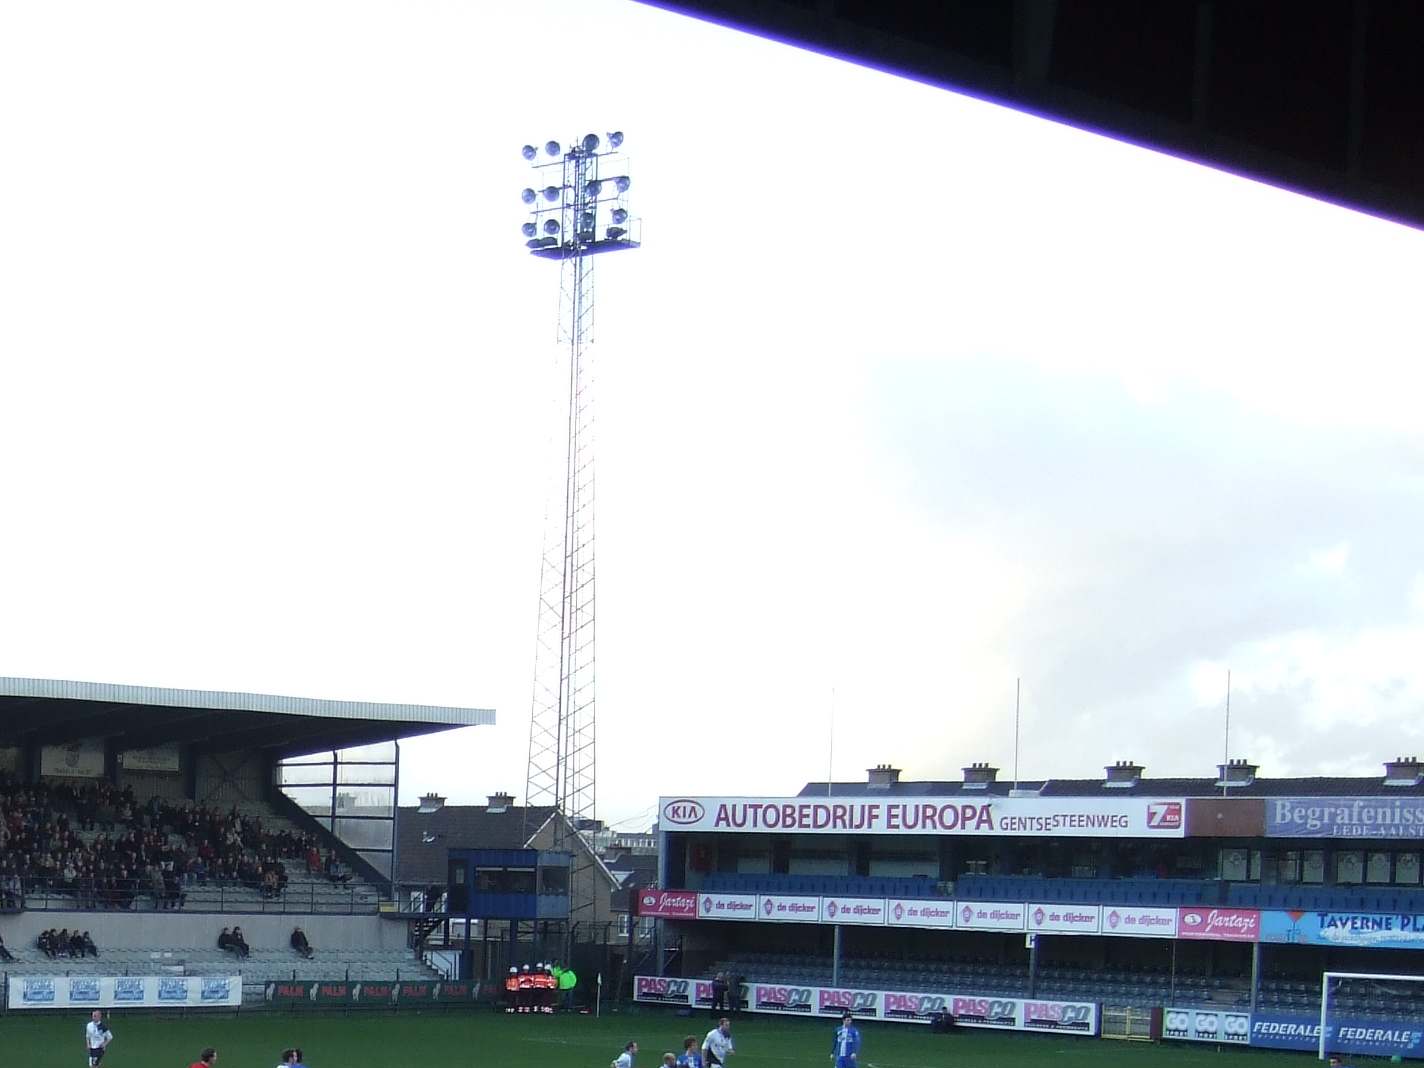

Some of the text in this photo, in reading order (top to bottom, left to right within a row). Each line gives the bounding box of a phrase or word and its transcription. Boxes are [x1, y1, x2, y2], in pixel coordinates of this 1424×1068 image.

[671, 806, 698, 819] KIA
[713, 803, 881, 830] AUTOBEDRIJF
[886, 804, 994, 831] EUROPA
[1049, 912, 1060, 921] de
[1205, 909, 1257, 931] Jartazi
[1317, 912, 1392, 931] TAVERNE
[1253, 1022, 1321, 1037] FEDERALE
[1338, 1027, 1411, 1042] FEDERALE
